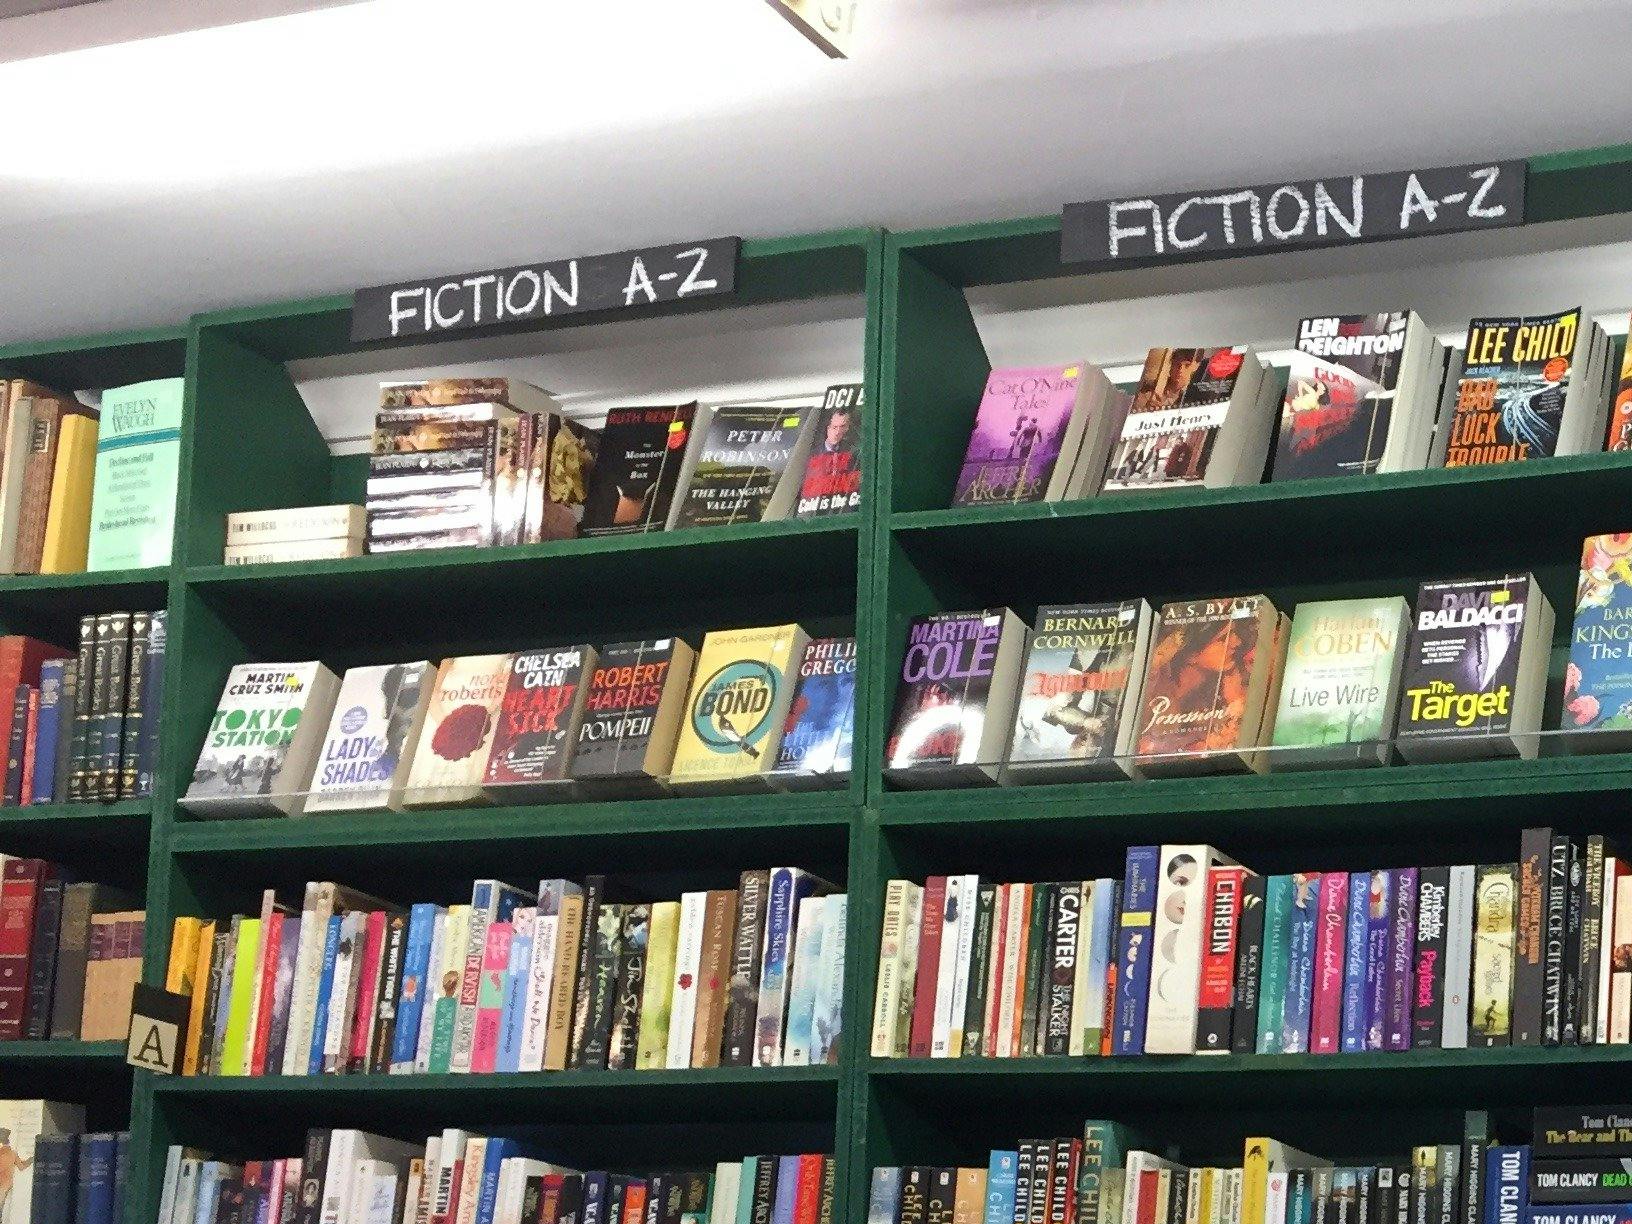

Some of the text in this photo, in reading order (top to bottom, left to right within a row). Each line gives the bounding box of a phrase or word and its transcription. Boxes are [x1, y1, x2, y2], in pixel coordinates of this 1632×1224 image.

[1108, 166, 1506, 258] FICTION A-Z
[388, 249, 717, 336] FICTION A-Z
[1300, 318, 1340, 341] LEN
[1468, 320, 1576, 364] LEE CHILD
[1299, 332, 1405, 356] DEIGHTON
[1134, 412, 1214, 434] Just Henry
[1452, 412, 1502, 445] LUCK
[727, 429, 782, 444] PETER
[702, 448, 791, 463] ROBINSON
[691, 486, 773, 499] THE HANGING
[706, 499, 751, 510] VALLEY
[1418, 604, 1522, 630] BALDACCI
[911, 619, 1000, 643] MARTINA
[1034, 630, 1136, 650] CORNWELL
[1295, 629, 1392, 657] COBEN
[514, 651, 580, 673] CHELSEA
[904, 639, 998, 683] COLE
[1590, 643, 1632, 661] The
[524, 669, 564, 689] CAIN
[592, 662, 668, 687] ROBERT
[230, 684, 261, 696] CRUZ
[504, 685, 573, 711] HEART
[588, 685, 664, 710] HARRIS
[714, 680, 754, 697] JAMES
[1289, 684, 1379, 708] Live Wire
[1430, 680, 1454, 695] The
[700, 687, 768, 716] BOND
[1407, 684, 1510, 726] Target
[212, 707, 303, 732] TOKYO
[508, 712, 558, 736] SICK
[1144, 696, 1225, 733] Possession
[212, 729, 296, 747] STATION
[579, 716, 651, 742] POMPEII
[326, 736, 376, 760] LADY
[321, 760, 391, 785] SHADES
[1212, 882, 1238, 954] CHABON
[1417, 882, 1434, 942] CHAMBERS
[1430, 885, 1445, 938] Kimberley
[1055, 894, 1079, 968] CARTER
[1416, 949, 1437, 1007] Payback
[133, 1026, 169, 1069] A
[1581, 1115, 1604, 1128] Tom
[1084, 1125, 1103, 1168] LEE
[1546, 1131, 1566, 1143] The
[1568, 1130, 1592, 1143] Bear
[1595, 1131, 1616, 1143] and
[1501, 1151, 1520, 1184] TOM
[1014, 1143, 1032, 1224] LEE CHILD
[1536, 1173, 1598, 1188] TOM CLANCY
